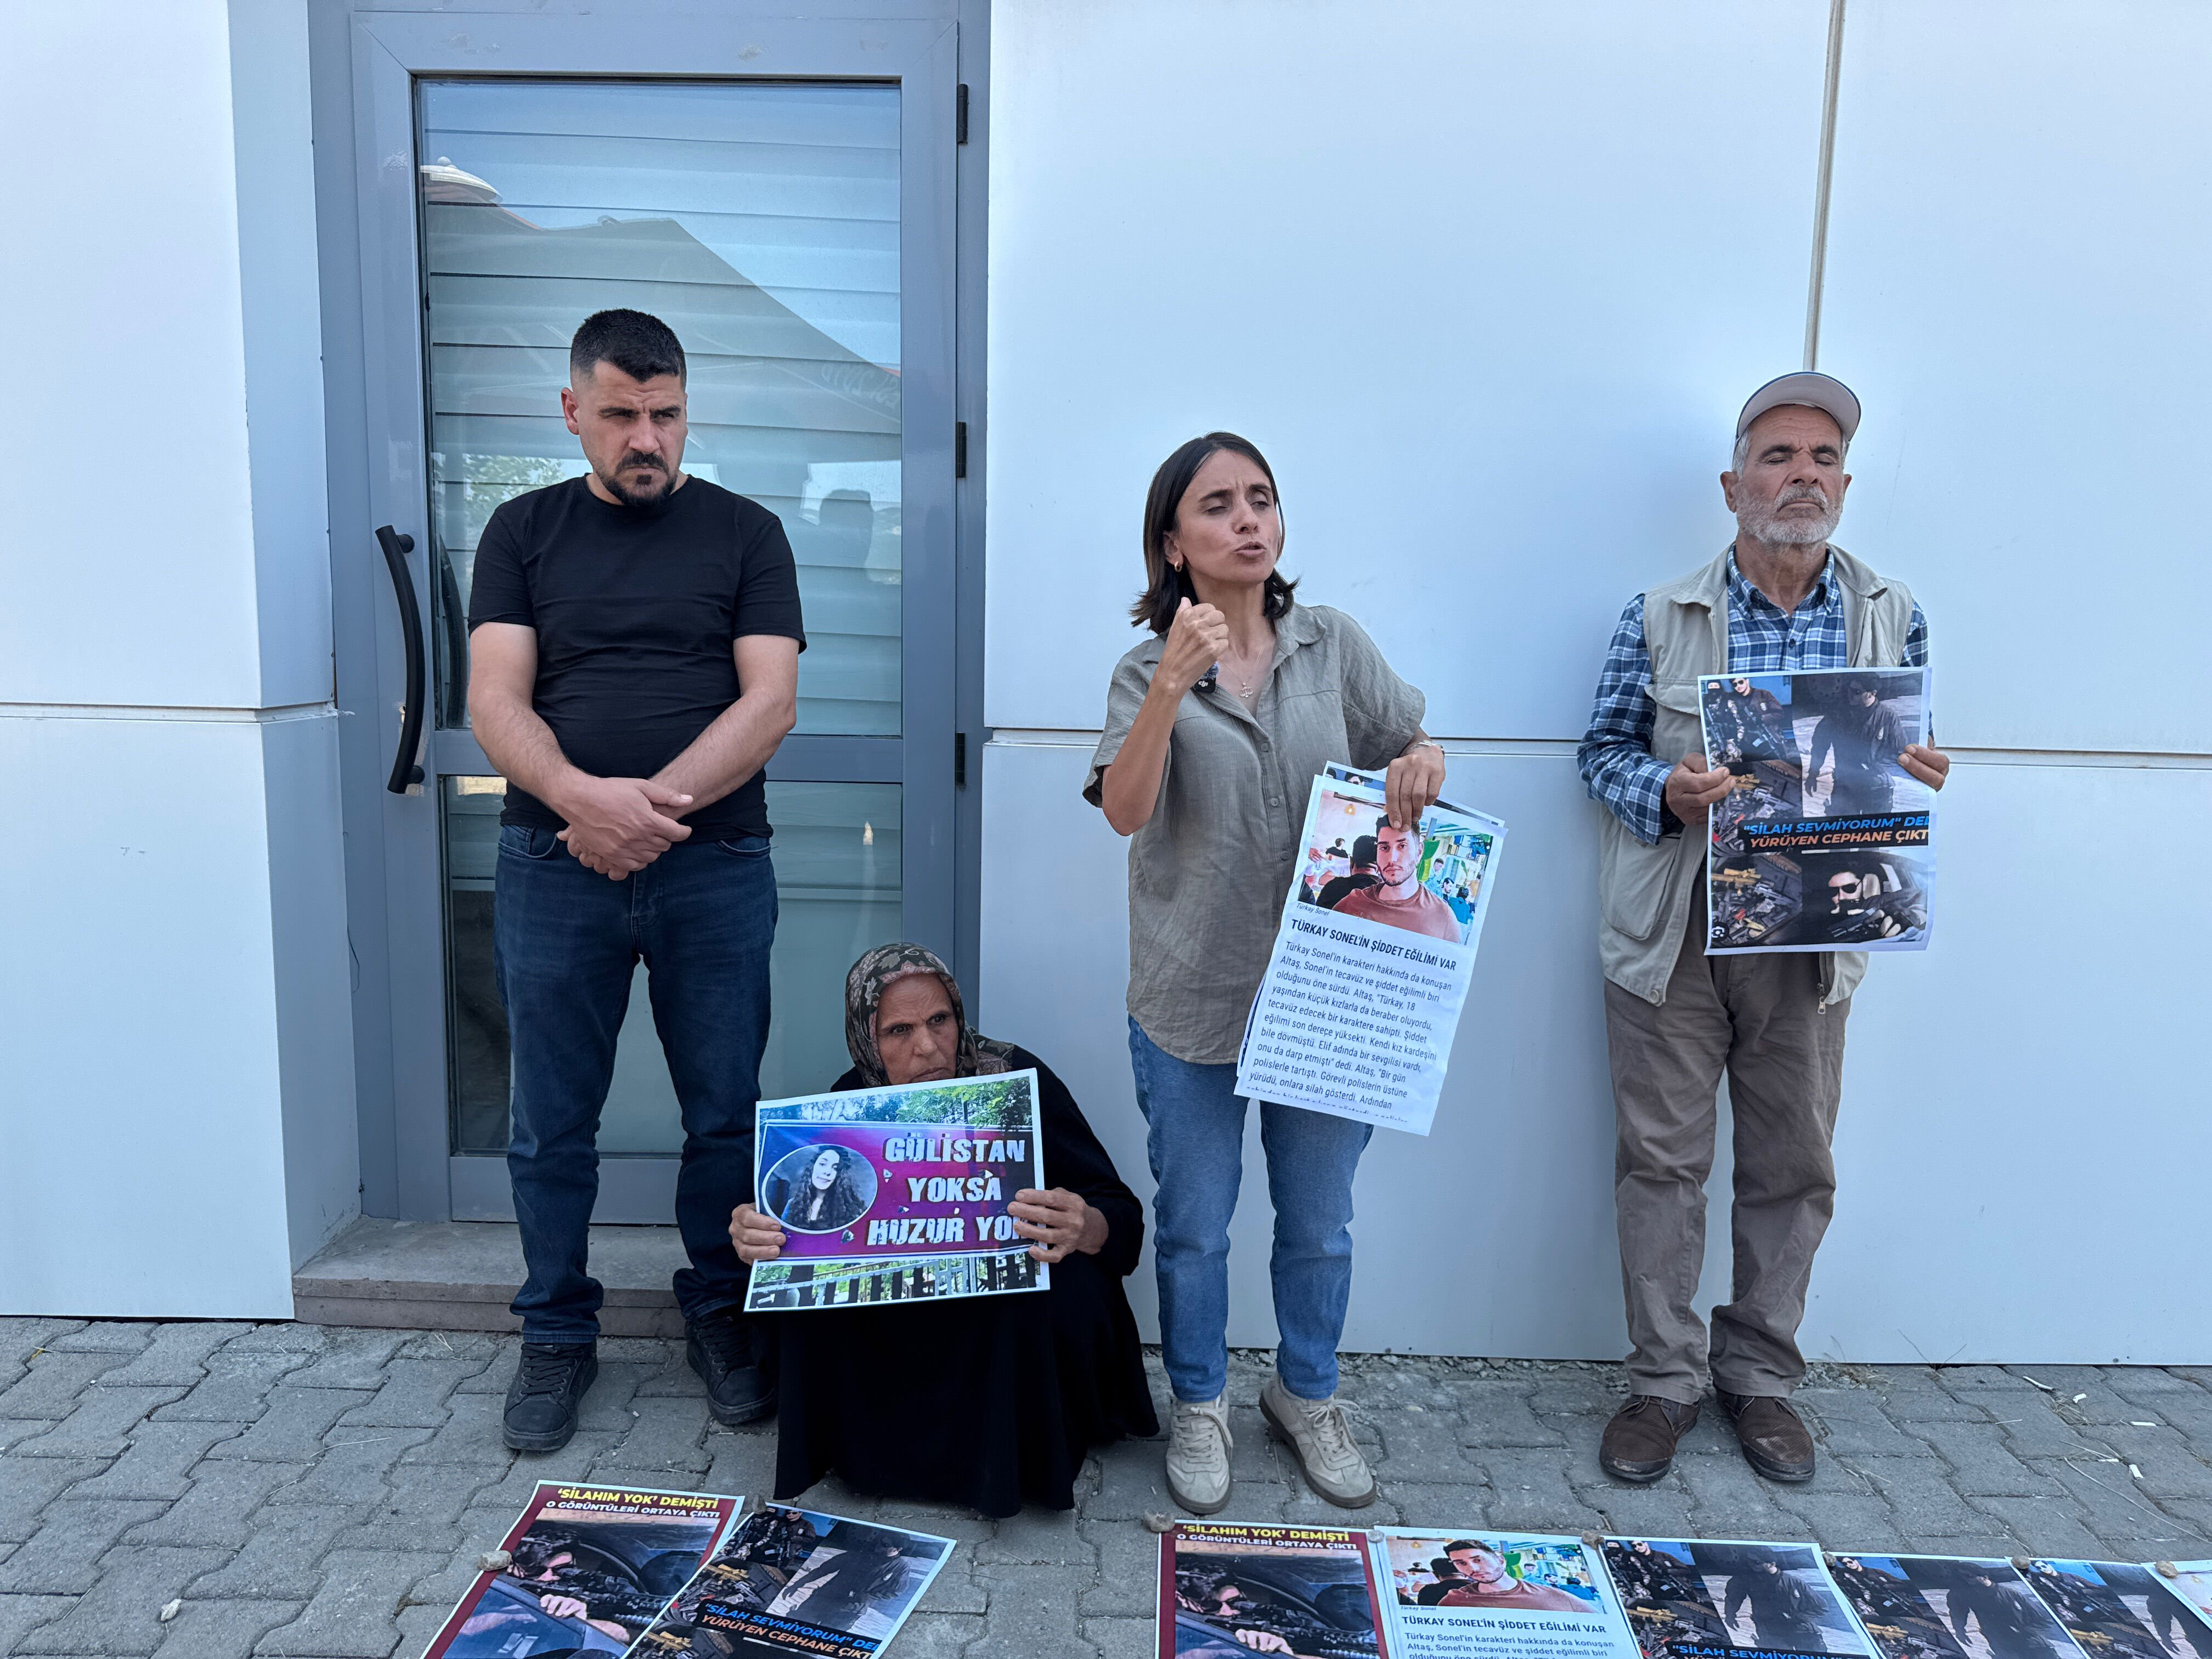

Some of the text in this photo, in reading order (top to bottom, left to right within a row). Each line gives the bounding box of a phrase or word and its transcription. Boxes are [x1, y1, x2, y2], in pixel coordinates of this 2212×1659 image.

[1743, 822, 1793, 835] "SİLAH
[1796, 817, 1901, 833] SEVMİYORUM"
[1750, 833, 1818, 848] YÜRÜYEN
[1821, 831, 1893, 844] CEPHANE
[1291, 918, 1457, 971] TÜRKAY SONEL'İN ŞİDDET EĞİLİMİ VAR
[1286, 940, 1452, 991] Türkay Sonel'in karakteri hakkında da konuşan
[1304, 961, 1333, 976] Sonel'in
[1335, 969, 1364, 984] tecavüz
[1365, 978, 1374, 986] ve
[1375, 980, 1398, 992] şiddet
[1399, 985, 1426, 999] eğilimli
[1271, 985, 1306, 1000] yaşından
[1307, 991, 1330, 1006] küçük
[1331, 997, 1358, 1012] kızlarla
[1359, 1005, 1369, 1015] da
[1370, 1007, 1399, 1022] beraber
[1276, 970, 1311, 985] olduğunu
[1312, 978, 1327, 990] öne
[1407, 1001, 1415, 1011] 18
[1264, 1013, 1291, 1026] eğilimi
[1291, 1020, 1306, 1030] son
[1369, 1037, 1390, 1049] Kendi
[1391, 1042, 1403, 1053] kız
[1268, 998, 1298, 1013] tecavüz
[1299, 1006, 1326, 1020] edecek
[1327, 1011, 1338, 1022] bir
[1339, 1014, 1374, 1031] karaktere
[1403, 1030, 1427, 1043] Şiddet
[1261, 1026, 1276, 1039] bile
[1318, 1040, 1332, 1051] Elif
[1333, 1045, 1358, 1057] adında
[1359, 1049, 1370, 1060] bir
[1371, 1053, 1401, 1067] sevgilisi
[1252, 1058, 1289, 1072] polislerle
[1321, 1071, 1346, 1085] Görevli
[1346, 1079, 1381, 1092] polislerin
[1383, 1085, 1407, 1098] üstüne
[1257, 1043, 1273, 1053] onu
[1274, 1045, 1284, 1056] da
[1285, 1048, 1303, 1061] darp
[1391, 1074, 1406, 1083] gün
[1279, 1079, 1304, 1090] onlara
[1305, 1084, 1323, 1094] silah
[1359, 1094, 1392, 1109] Ardından
[885, 1132, 1025, 1163] GÜLİSTAN
[907, 1177, 1002, 1202] YOKSA
[867, 1217, 965, 1246] HUZUR
[558, 1500, 639, 1514] GÖRÜNTÜLERİ
[641, 1507, 687, 1516] ORTAYA
[659, 1497, 719, 1510] DEMİŞTİ
[1189, 1533, 1272, 1545] GÖRÜNTÜLERİ
[1275, 1540, 1323, 1549] ORTAYA
[1325, 1542, 1357, 1550] ÇIKTI
[1290, 1530, 1350, 1543] DEMİŞTİ
[702, 1615, 768, 1636] YÜRÜYEN
[769, 1630, 838, 1652] CEPHANE
[705, 1603, 751, 1620] "SİLAH
[752, 1615, 853, 1643] SEVMİYORUM"
[1402, 1615, 1444, 1626] TÜRKAY
[1498, 1620, 1537, 1630] ŞİDDET
[1539, 1621, 1581, 1632] EĞİLİMİ
[1582, 1624, 1607, 1633] VAR
[1404, 1632, 1435, 1642] Türkay
[1475, 1635, 1515, 1644] karakteri
[1517, 1637, 1559, 1645] hakkında
[1575, 1639, 1615, 1647] konuşan
[1556, 1648, 1590, 1656] eğilimli
